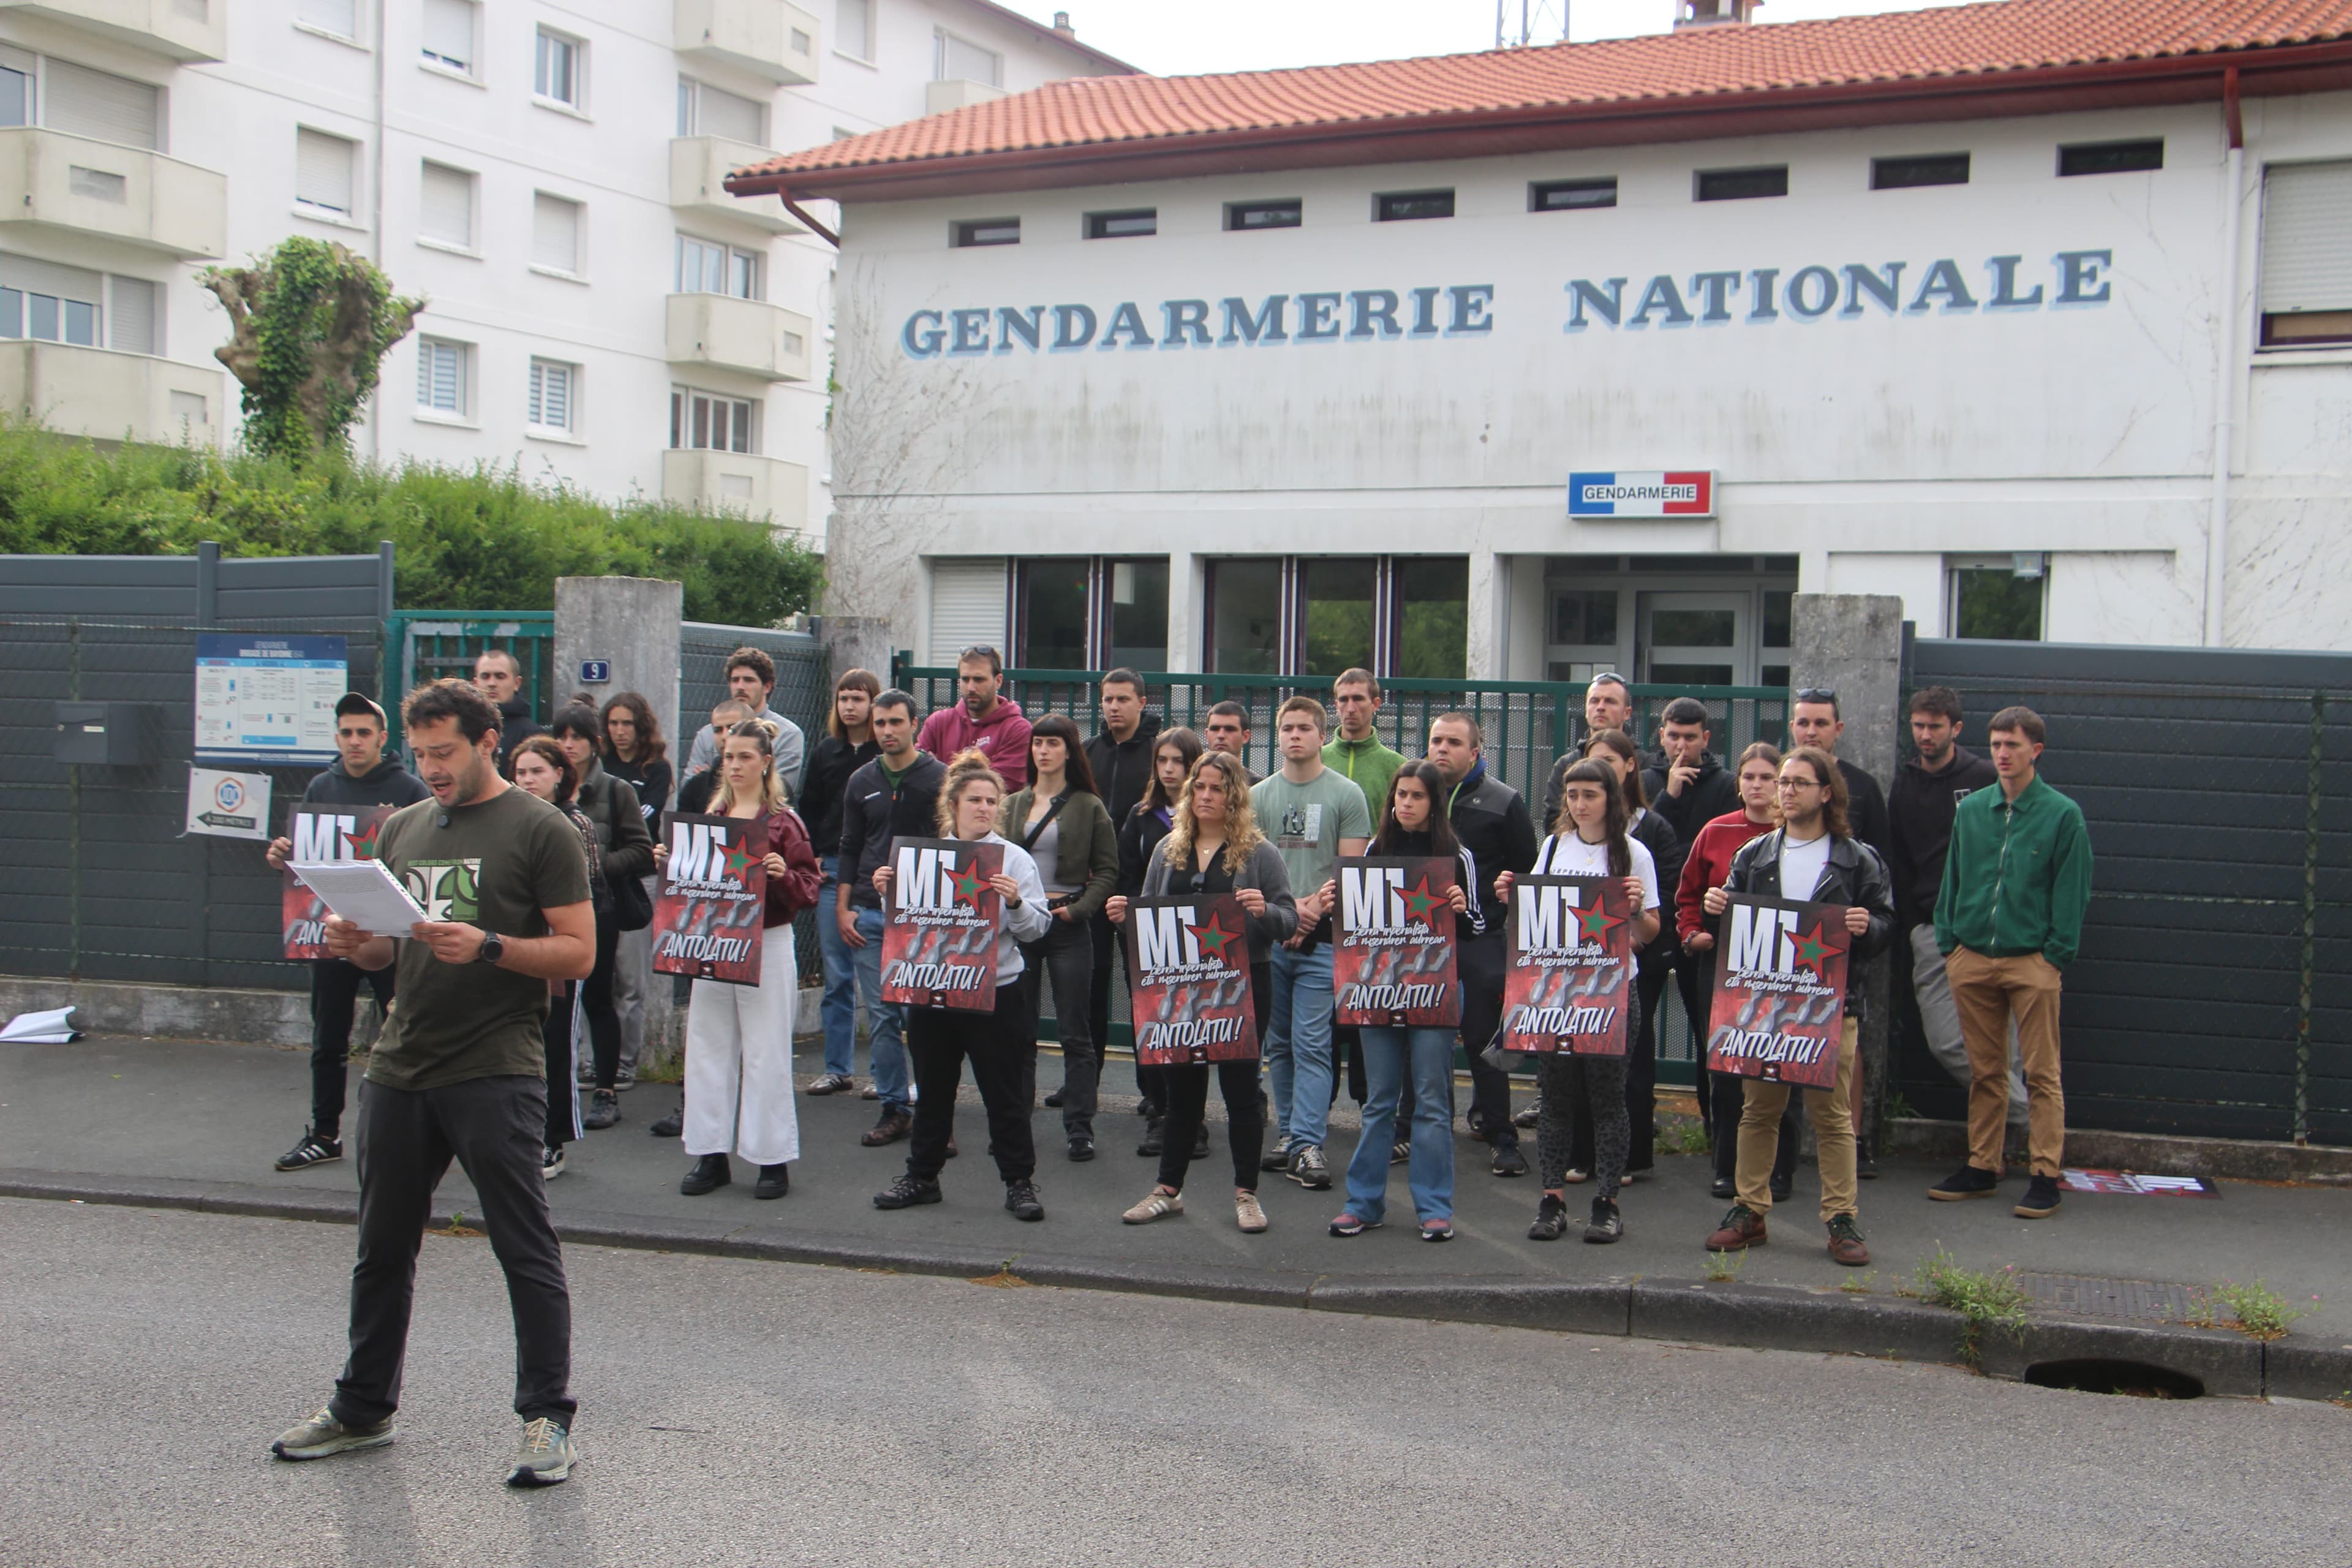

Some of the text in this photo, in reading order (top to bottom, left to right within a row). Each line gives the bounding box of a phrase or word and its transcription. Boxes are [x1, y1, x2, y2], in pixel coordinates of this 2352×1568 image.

[901, 249, 2113, 361] GENDARMERIE NATIONALE
[1583, 486, 1697, 500] GENDARMERIE
[591, 663, 599, 679] 9
[665, 886, 677, 896] eta
[894, 914, 907, 924] eta
[663, 932, 752, 962] ANTOLATU!
[1343, 935, 1358, 947] eta
[1517, 955, 1531, 967] eta
[891, 961, 986, 990] ANTOLATU!
[1141, 975, 1155, 987] eta
[1725, 976, 1741, 988] eta
[1346, 982, 1446, 1011] ANTOLATU!
[1514, 1005, 1616, 1036] ANTOLATU!
[1147, 1016, 1244, 1050] ANTOLATU!
[1719, 1028, 1826, 1064] ANTOLATU!
